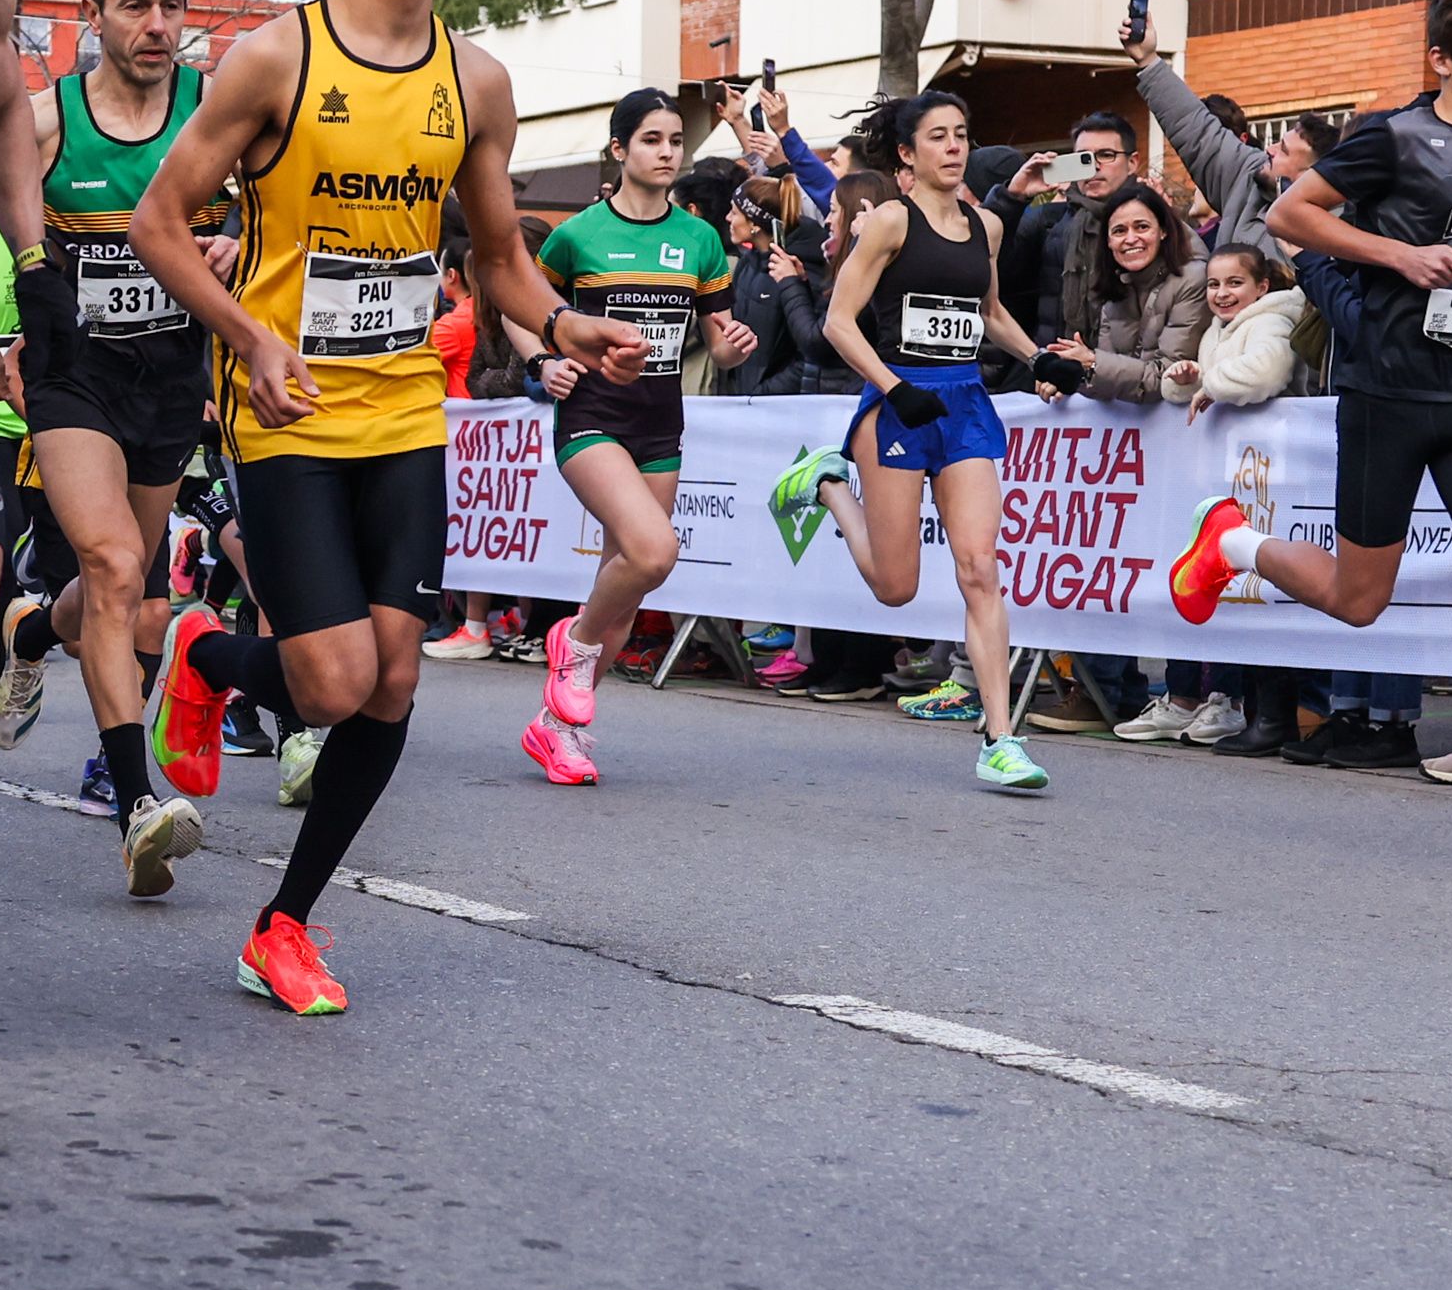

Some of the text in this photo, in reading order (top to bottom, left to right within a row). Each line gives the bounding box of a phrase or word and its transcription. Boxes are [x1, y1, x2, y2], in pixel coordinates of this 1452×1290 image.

[338, 203, 397, 211] ASCENSORES
[65, 243, 134, 259] CERDA
[358, 280, 392, 304] PAU
[607, 293, 691, 306] CERDANYOLA
[311, 311, 338, 320] MITJA
[312, 318, 336, 326] SANT
[350, 308, 393, 332] 3221
[308, 324, 339, 333] CUGAT
[669, 327, 680, 340] ??
[927, 316, 973, 340] 3310
[649, 345, 663, 358] 85
[455, 419, 542, 463] MITJA
[1002, 427, 1144, 486] MITJA
[456, 466, 538, 513] SANT
[675, 493, 735, 519] NTANYENC
[1001, 488, 1138, 549] SANT
[445, 513, 549, 563] CUGAT
[1289, 522, 1334, 551] CLUB
